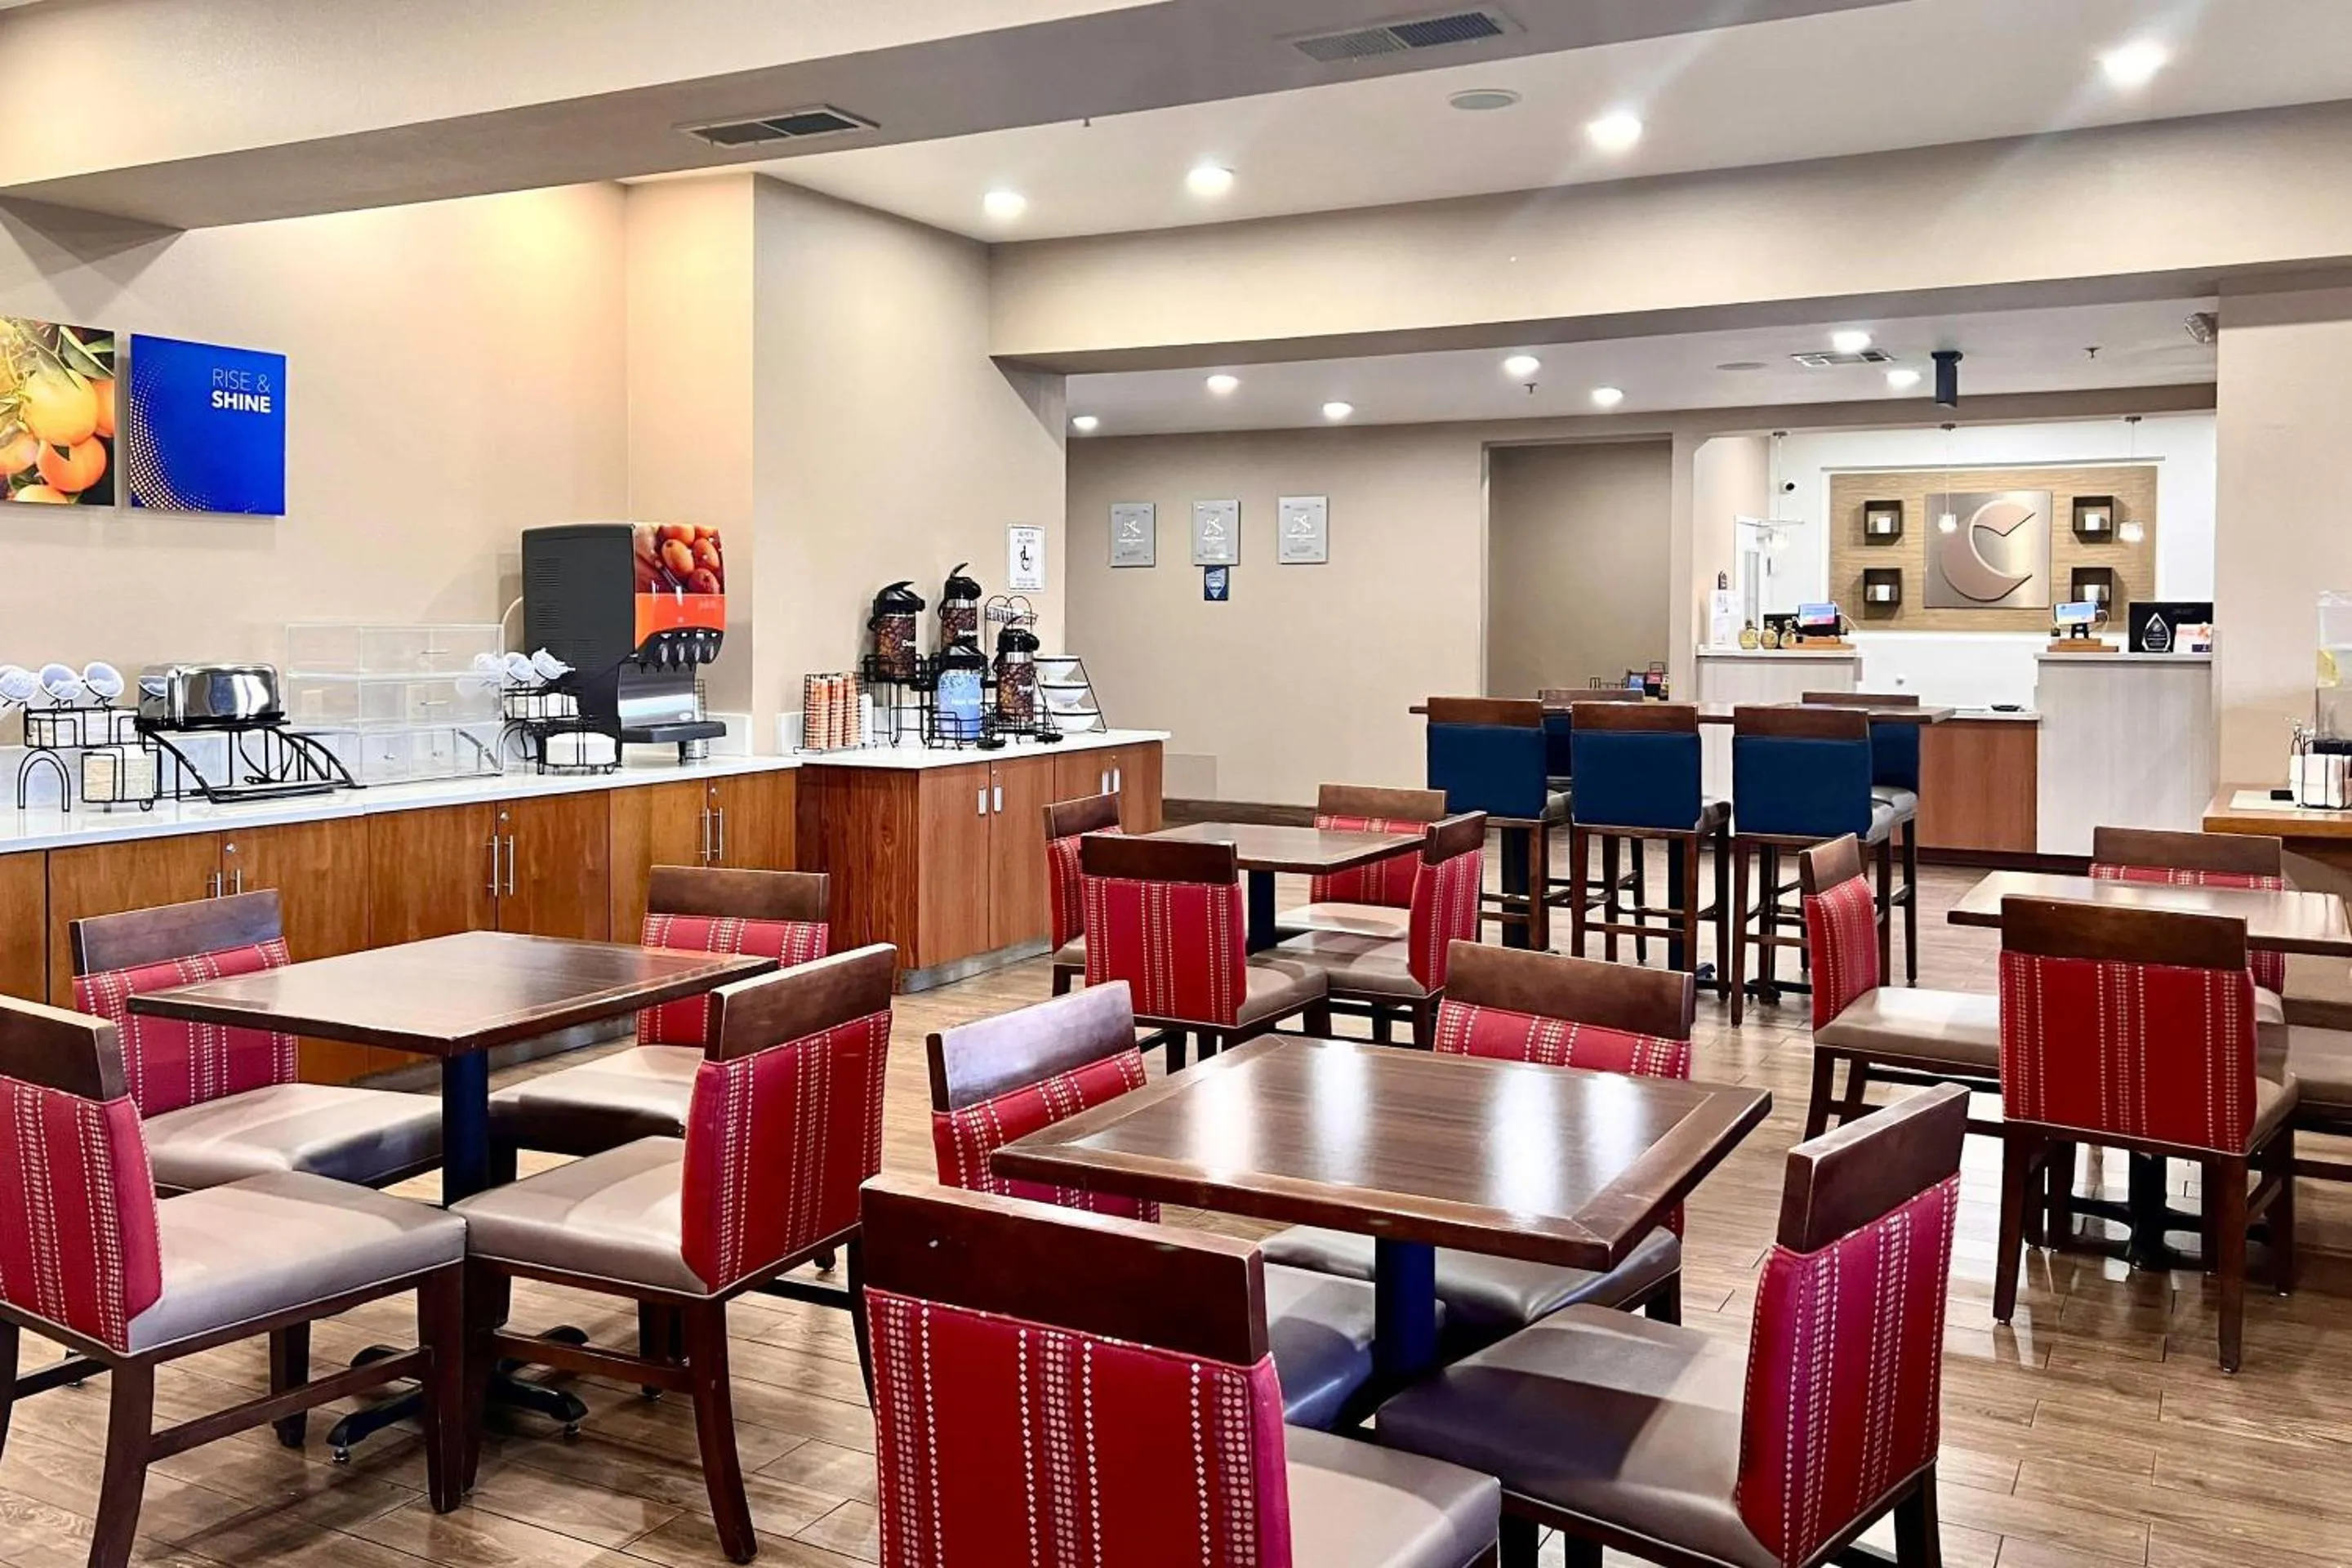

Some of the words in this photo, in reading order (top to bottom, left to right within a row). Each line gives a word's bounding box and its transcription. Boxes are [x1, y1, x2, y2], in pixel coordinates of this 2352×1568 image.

[212, 368, 252, 391] RISE
[257, 373, 271, 394] &
[212, 390, 271, 413] SHINE
